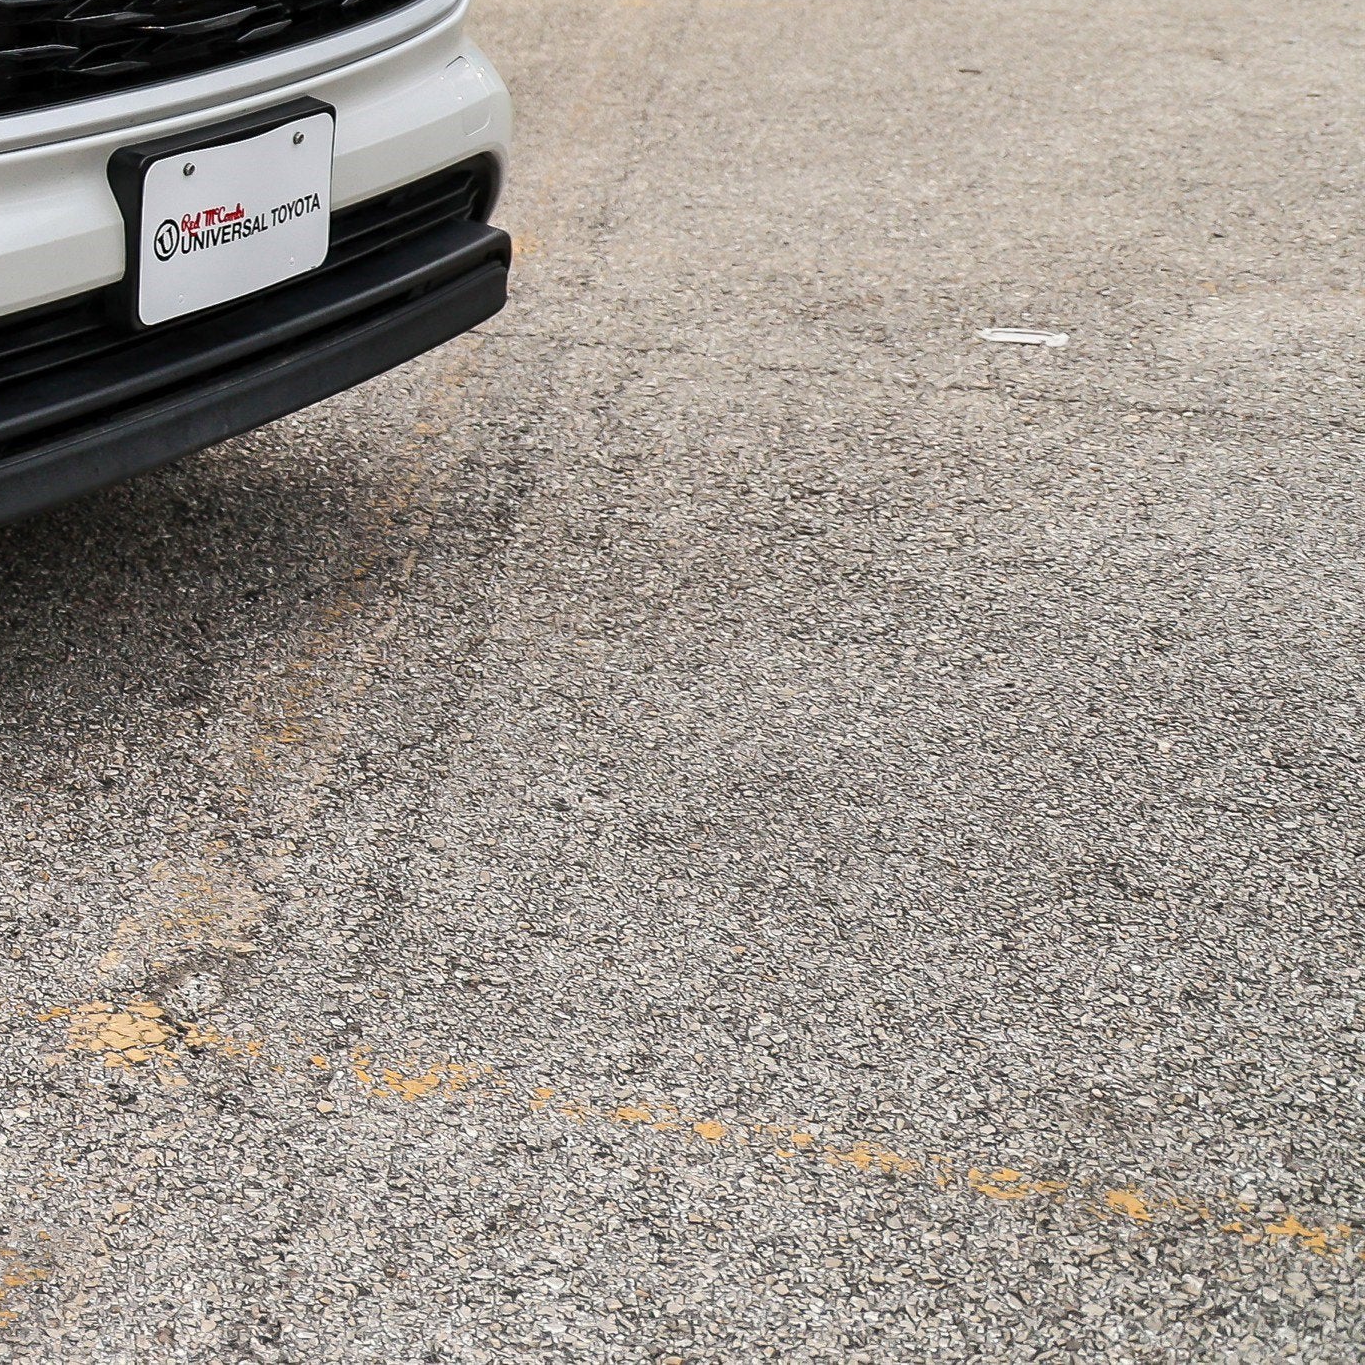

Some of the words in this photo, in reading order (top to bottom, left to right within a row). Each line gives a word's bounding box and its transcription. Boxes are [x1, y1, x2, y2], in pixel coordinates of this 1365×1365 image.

[181, 215, 269, 255] UNIVERSAL
[271, 192, 322, 227] TOYOTA
[181, 212, 201, 237] Red
